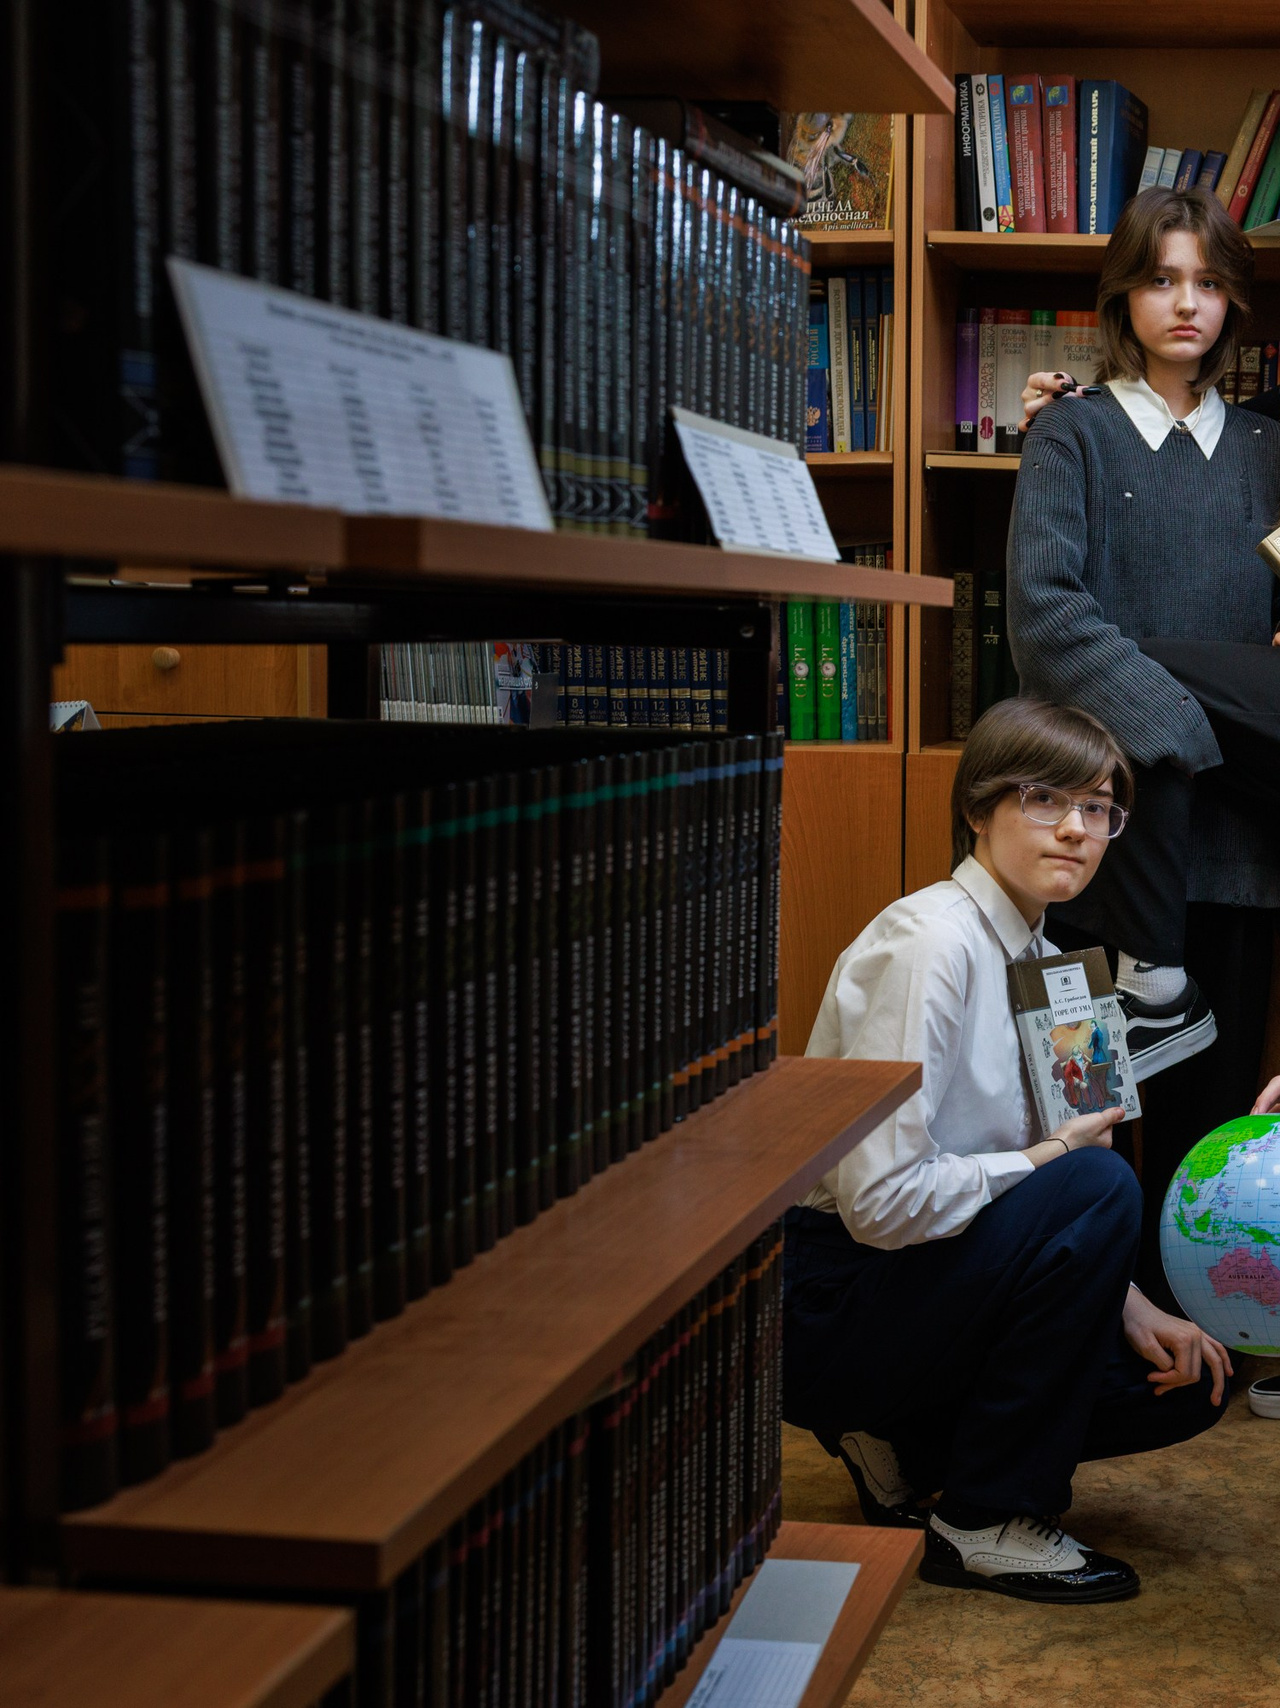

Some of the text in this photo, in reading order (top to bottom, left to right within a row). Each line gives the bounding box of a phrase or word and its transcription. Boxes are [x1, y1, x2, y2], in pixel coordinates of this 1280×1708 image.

[960, 80, 972, 158] ИНФОРМАТИКА
[977, 98, 987, 138] ИСТОРИКА
[993, 98, 1003, 152] МАТЕМАТИКА
[1014, 110, 1024, 219] ЭНЦИКЛОПЕДИЧЕСКИЙ СЛОВАРЬ
[1090, 89, 1100, 234] УССКО-АНГЛИЙСКИЙ СЛОВАРЬ
[1023, 135, 1031, 210] ИЛЛЮСТРИРОВАННЫЙ
[806, 199, 853, 213] ПЧЕЛА
[788, 210, 870, 225] медоносная
[822, 223, 839, 232] Apis
[833, 288, 842, 330] БОЛЬШАЯ
[810, 328, 820, 366] РОССИИ
[987, 324, 995, 358] ЯЗЫКА
[1064, 336, 1096, 345] СЛОВАРЬ
[1063, 344, 1099, 353] РУССКОГО
[1067, 353, 1092, 362] ЯЗЫКА
[980, 362, 990, 409] СЛОВАРЬ
[836, 368, 845, 437] ЭНЦИКЛОПЕДИЯ
[848, 633, 856, 659] нашей
[794, 643, 807, 698] СПОРТ
[821, 643, 834, 698] СПОРТ
[571, 698, 579, 708] 8
[592, 698, 600, 709] 9
[612, 700, 624, 710] 10
[633, 700, 643, 710] 11
[653, 700, 665, 711] 12
[674, 700, 686, 711] 13
[695, 701, 708, 712] 14
[1064, 995, 1087, 1003] Грибоедов
[1054, 1004, 1092, 1017] ГОРЕ ОТ УМА
